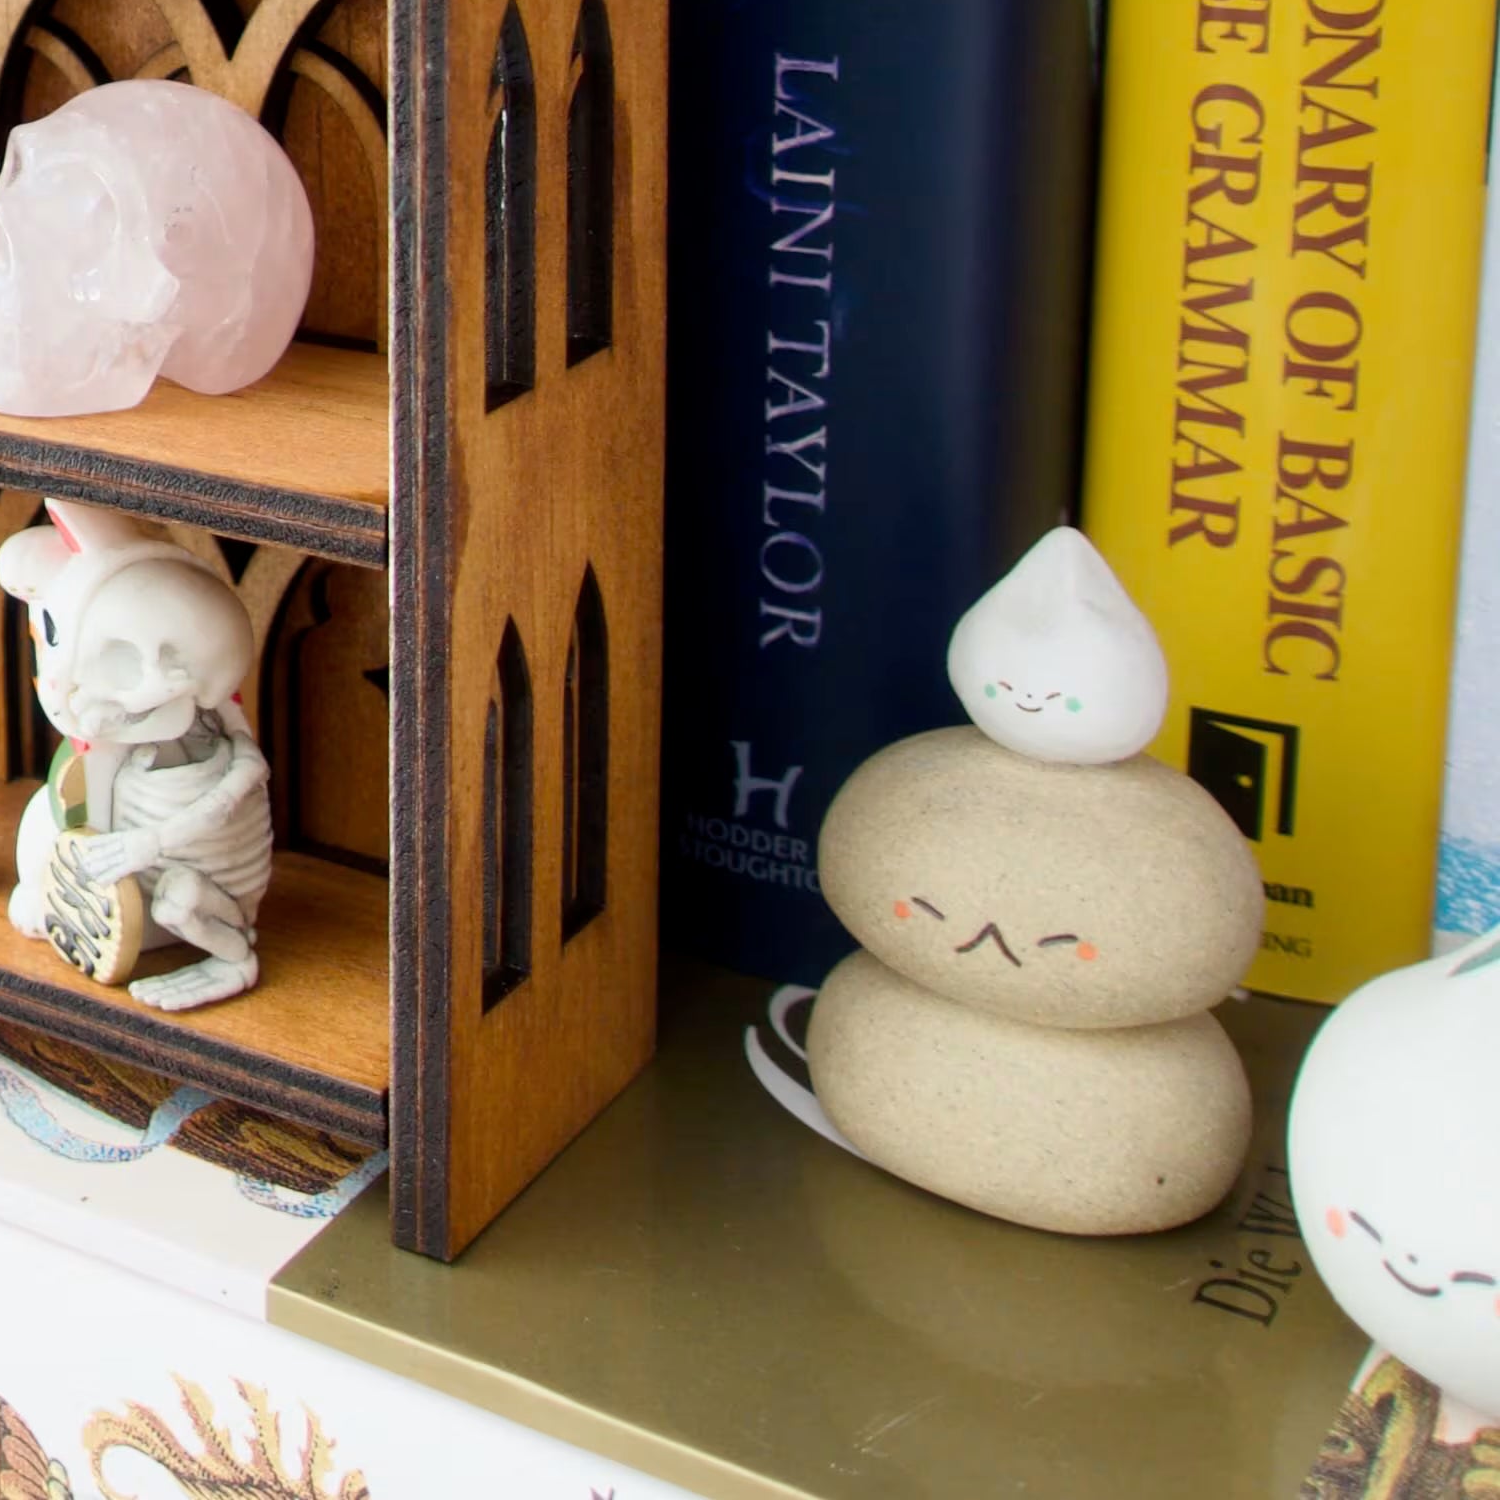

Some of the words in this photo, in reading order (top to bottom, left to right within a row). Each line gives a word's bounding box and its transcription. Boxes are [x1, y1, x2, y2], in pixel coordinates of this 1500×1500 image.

[768, 52, 839, 298] LAINI
[1167, 83, 1266, 549] GRAMMAR
[1284, 291, 1363, 412] OF
[758, 320, 831, 650] TAYLOR
[1259, 430, 1354, 681] BASIC
[680, 832, 820, 892] STOUGHTO
[687, 811, 808, 862] HODDER
[1193, 1249, 1302, 1327] Die
